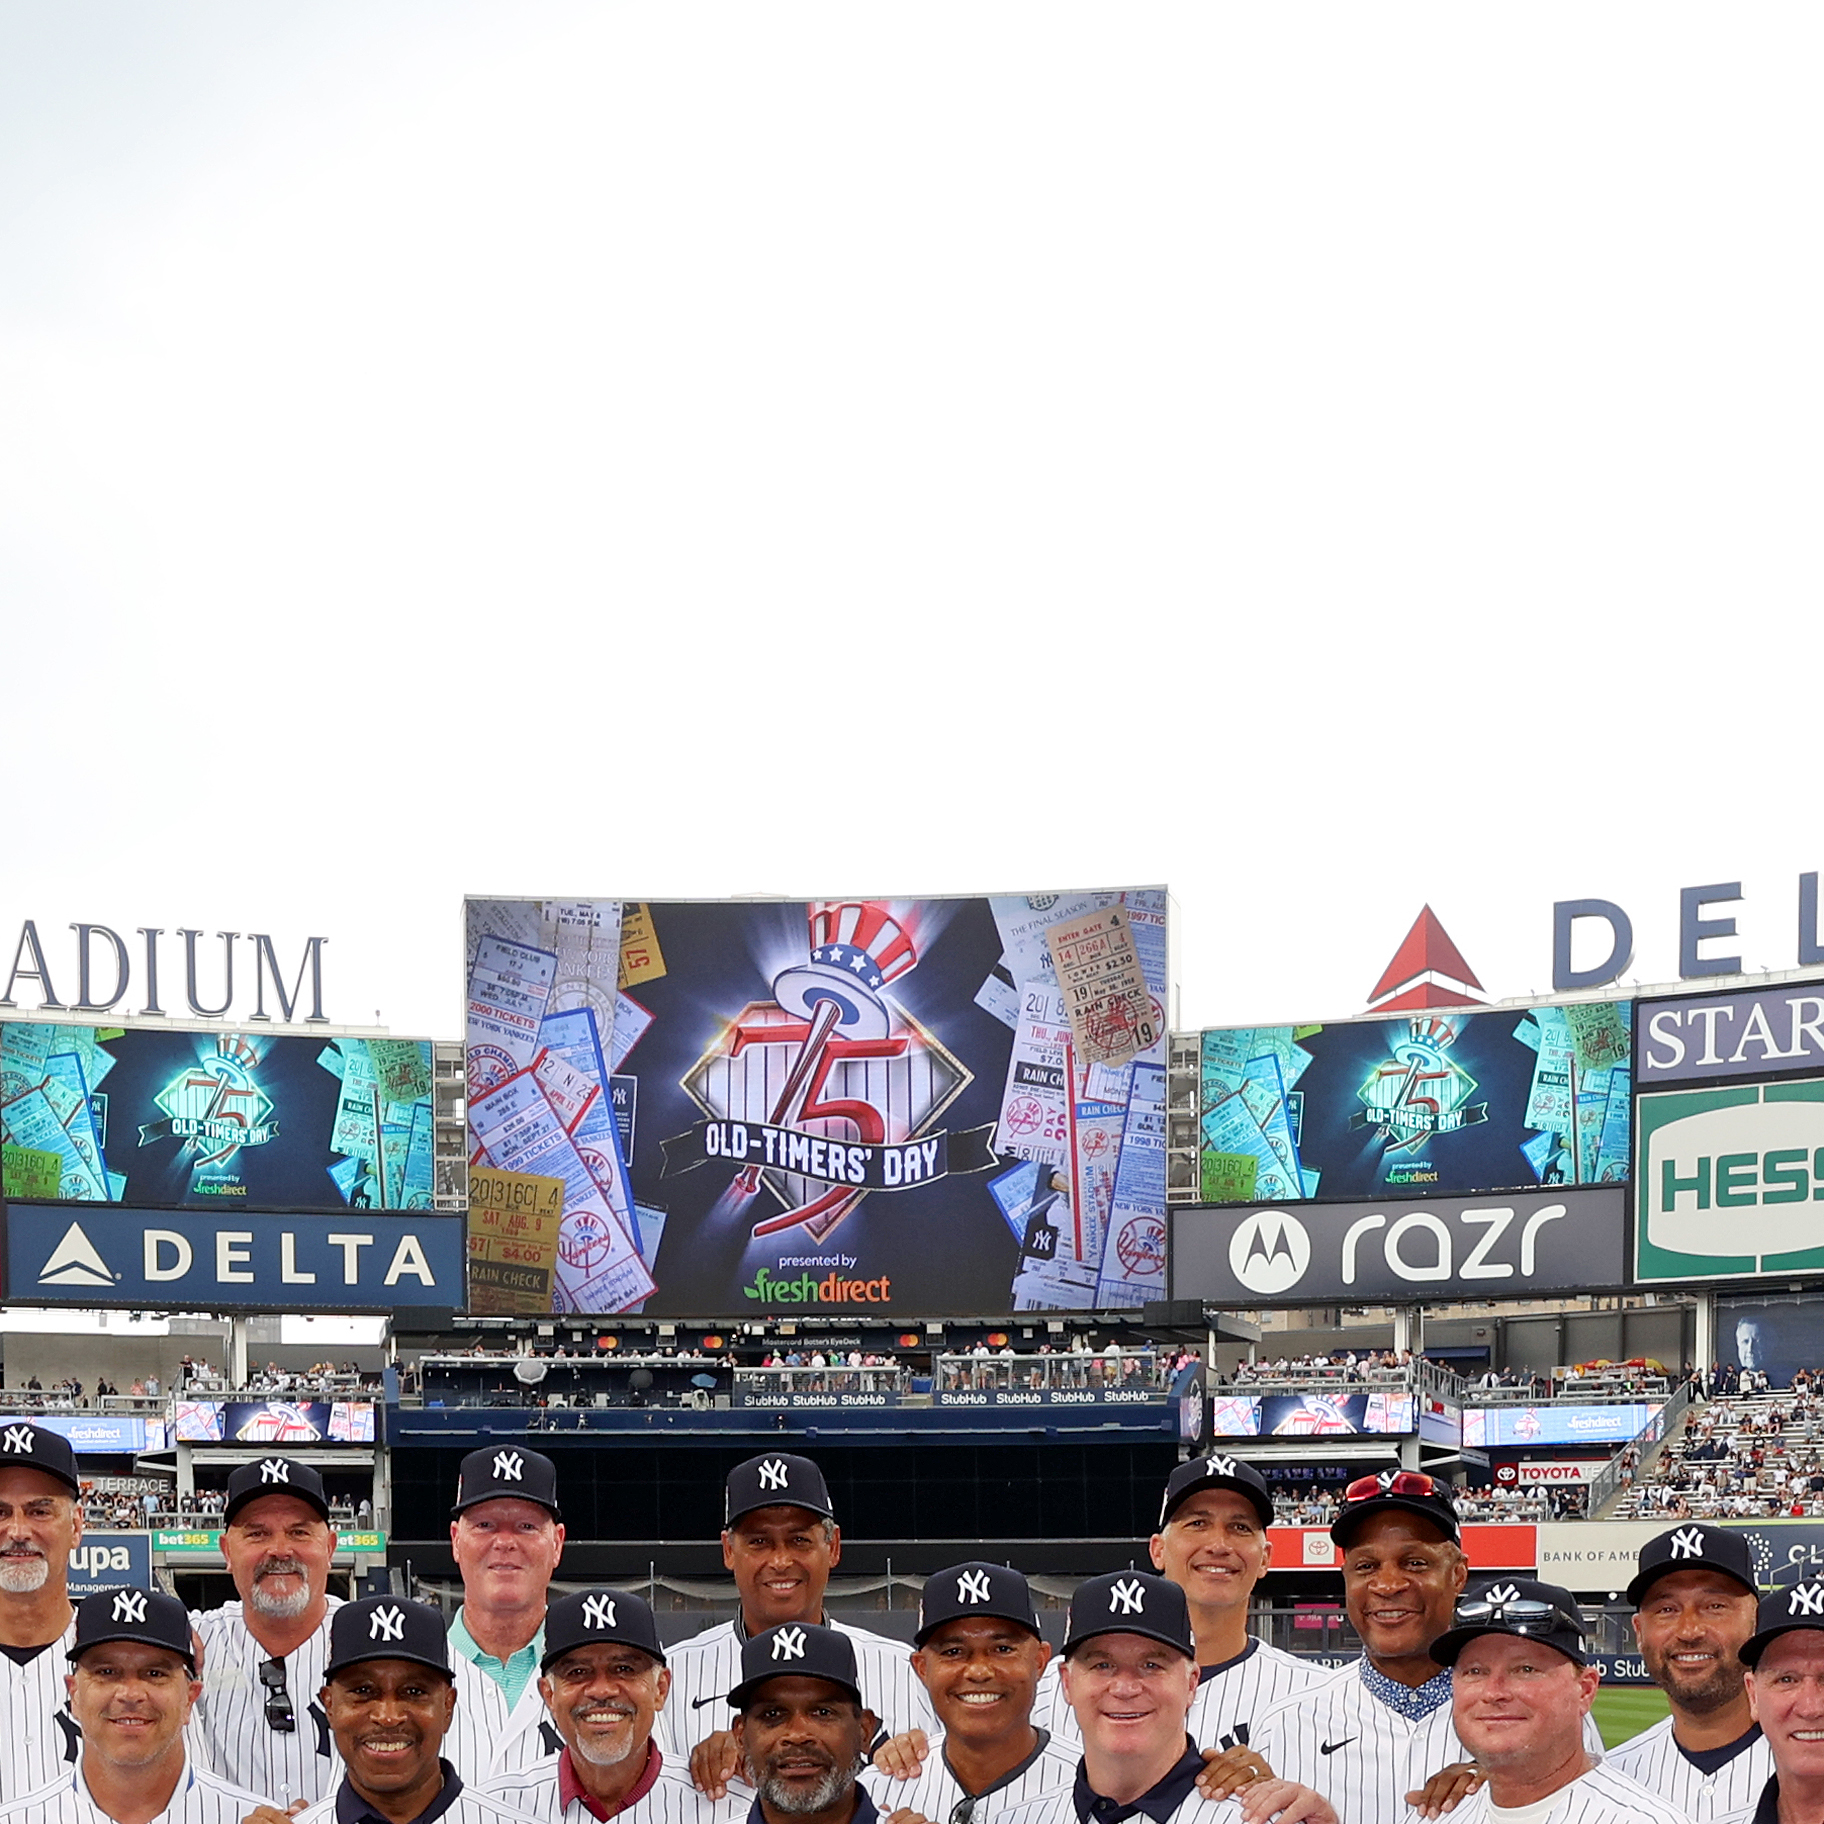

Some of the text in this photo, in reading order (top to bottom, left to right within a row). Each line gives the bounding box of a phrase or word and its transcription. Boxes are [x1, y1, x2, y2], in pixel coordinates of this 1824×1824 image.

[171, 1117, 269, 1143] OLD-TIMERS' DAY
[1366, 1107, 1463, 1131] OLD-TIMERS' DAY
[706, 1123, 938, 1185] OLD-TIMERS' DAY
[196, 1181, 247, 1196] freshdirect
[1389, 1169, 1439, 1184] freshdirect
[143, 1229, 435, 1287] DELTA
[1342, 1205, 1567, 1285] razr
[779, 1255, 857, 1268] presented by
[754, 1268, 891, 1303] freshdirect
[744, 1394, 885, 1407] StubHub StubHub StubHub
[941, 1390, 1149, 1405] StubHub StubHub StubHub StubHub
[70, 1427, 121, 1440] freshdirect
[1568, 1415, 1622, 1430] freshdirect
[2, 1423, 35, 1455] NY
[260, 1457, 290, 1485] NY
[493, 1446, 524, 1481] NY
[759, 1459, 788, 1489] NY
[1205, 1454, 1237, 1478] NY
[1521, 1466, 1581, 1480] TOYOTA
[97, 1477, 169, 1493] TERRACE
[159, 1533, 209, 1546] bet365
[1671, 1526, 1704, 1560] NY
[1543, 1551, 1605, 1562] BANK OF
[957, 1570, 990, 1603] NY
[1110, 1579, 1145, 1614] NY
[111, 1589, 148, 1624] NY
[582, 1594, 616, 1629] NY
[370, 1606, 405, 1641] NY
[772, 1627, 806, 1660] NY
